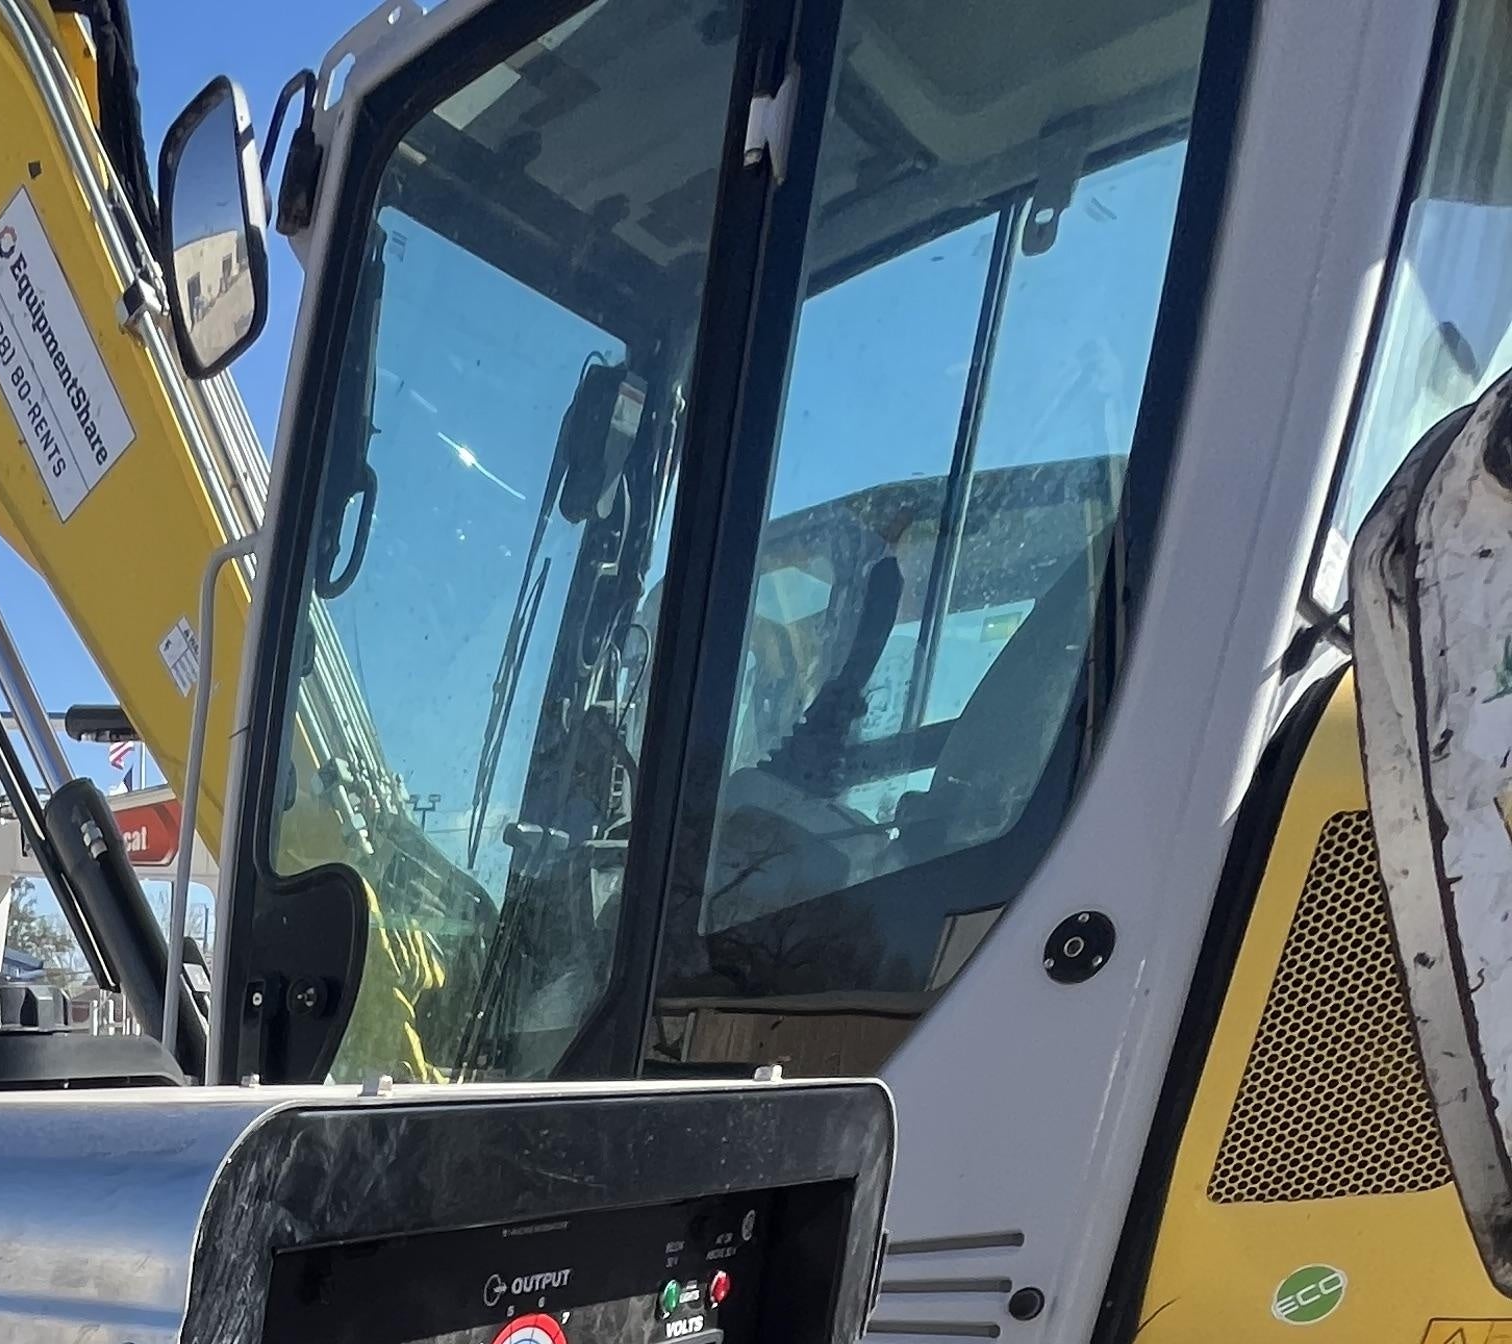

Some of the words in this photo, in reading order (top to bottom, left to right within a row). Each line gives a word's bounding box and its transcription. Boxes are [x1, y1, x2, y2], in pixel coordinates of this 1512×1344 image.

[10, 252, 108, 466] EquipmentShare
[11, 366, 67, 478] 80-RENTS
[511, 1268, 573, 1295] OUTPUT
[538, 1296, 545, 1308] 6
[1275, 1272, 1344, 1317] ECO
[507, 1305, 515, 1317] 5
[561, 1310, 570, 1324] 7
[666, 1315, 704, 1338] VOLTS
